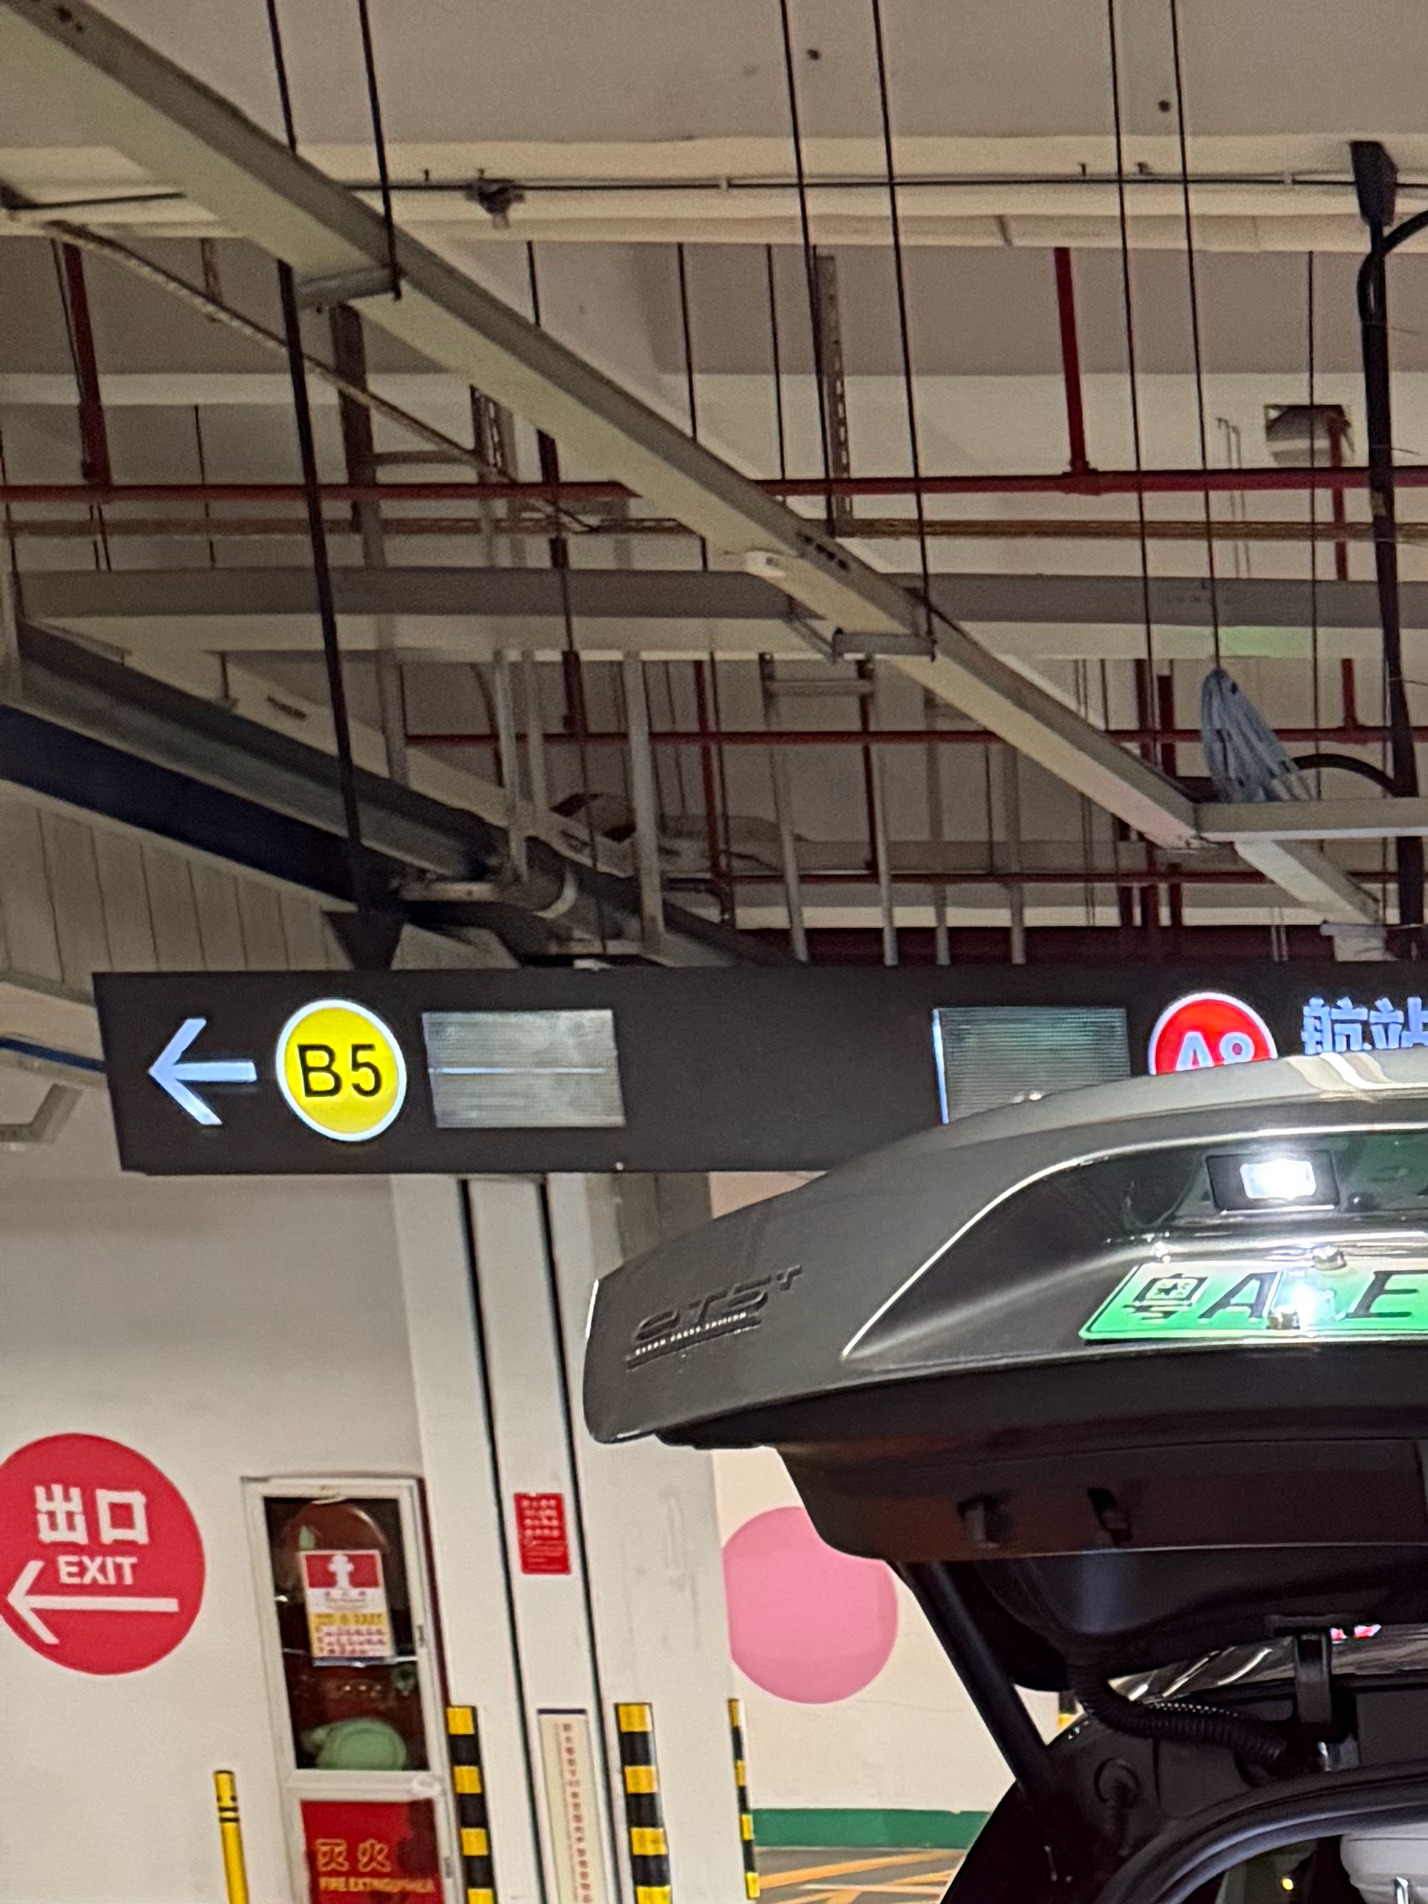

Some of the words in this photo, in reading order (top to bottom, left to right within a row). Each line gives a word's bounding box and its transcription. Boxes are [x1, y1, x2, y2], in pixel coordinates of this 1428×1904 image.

[297, 1043, 383, 1098] B5
[34, 1484, 149, 1545] 出口
[57, 1555, 138, 1585] EXIT
